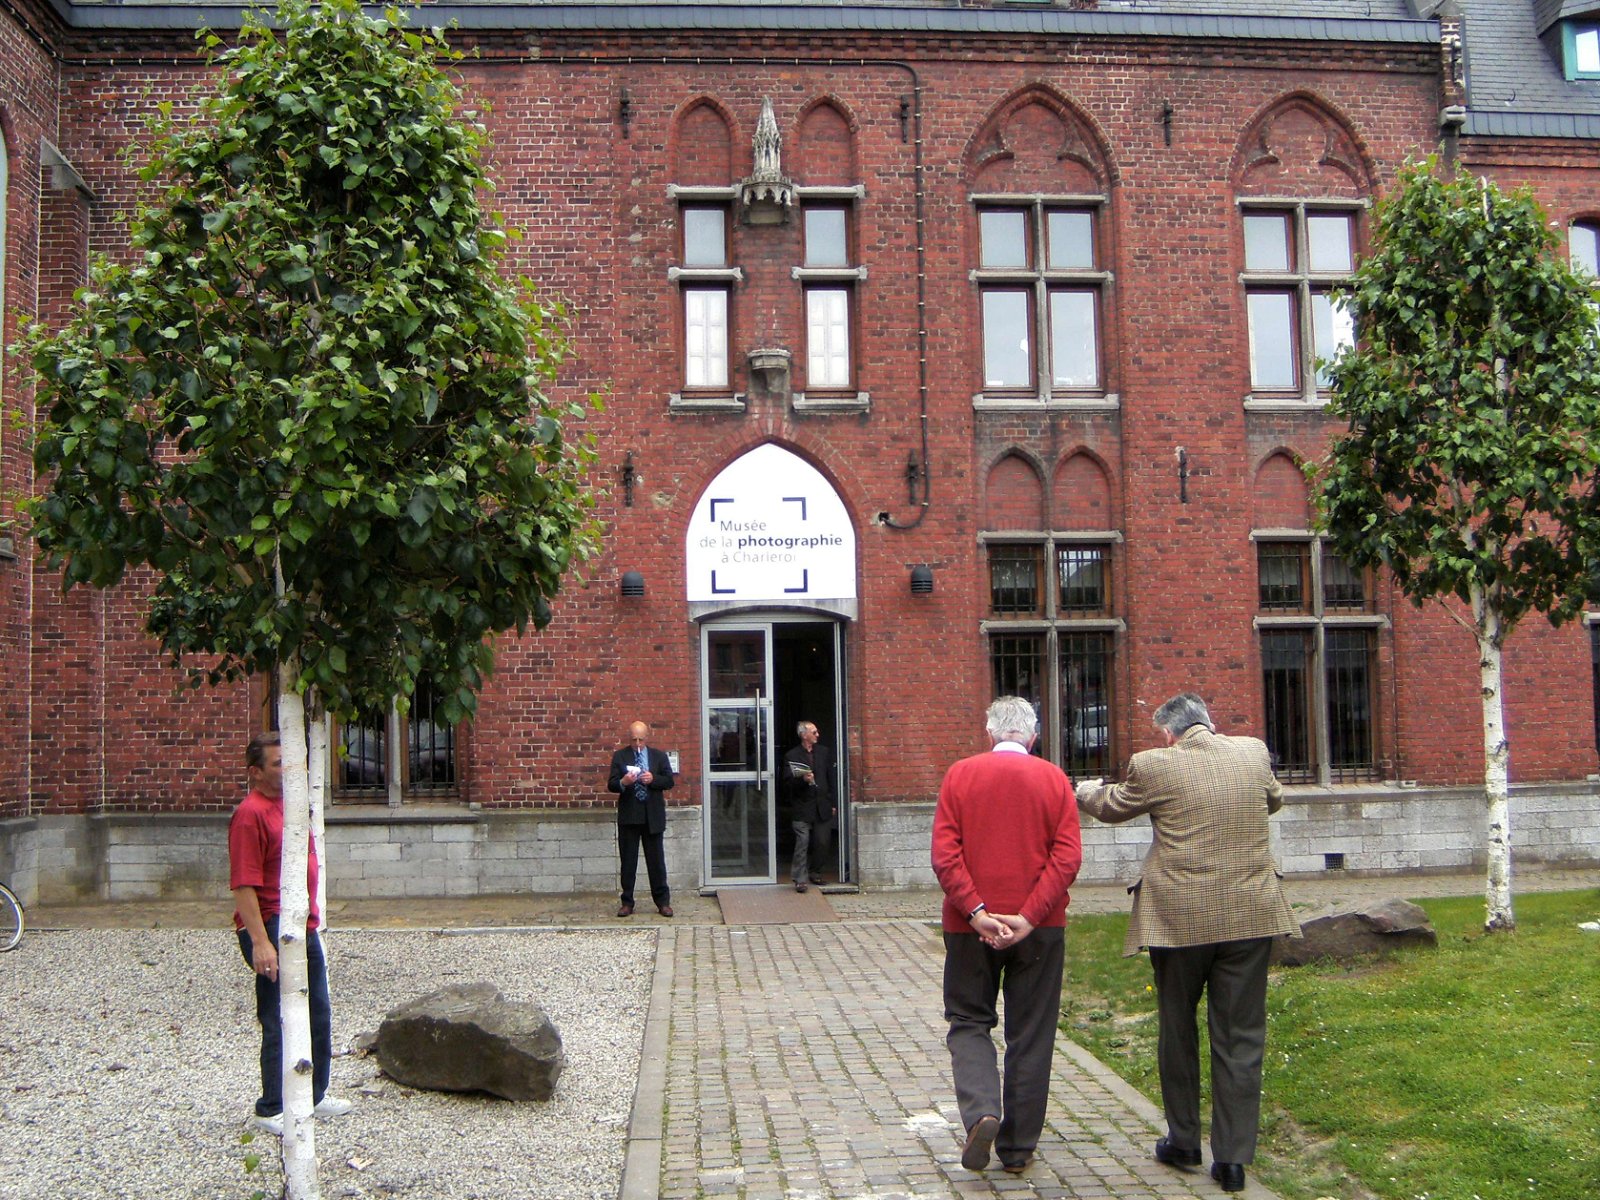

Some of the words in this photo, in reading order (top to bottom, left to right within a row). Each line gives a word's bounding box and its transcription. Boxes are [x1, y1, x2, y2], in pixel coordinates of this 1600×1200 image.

[720, 519, 767, 531] Musée
[699, 536, 717, 548] de
[721, 535, 733, 548] la
[738, 534, 843, 549] photographie
[721, 552, 729, 564] à
